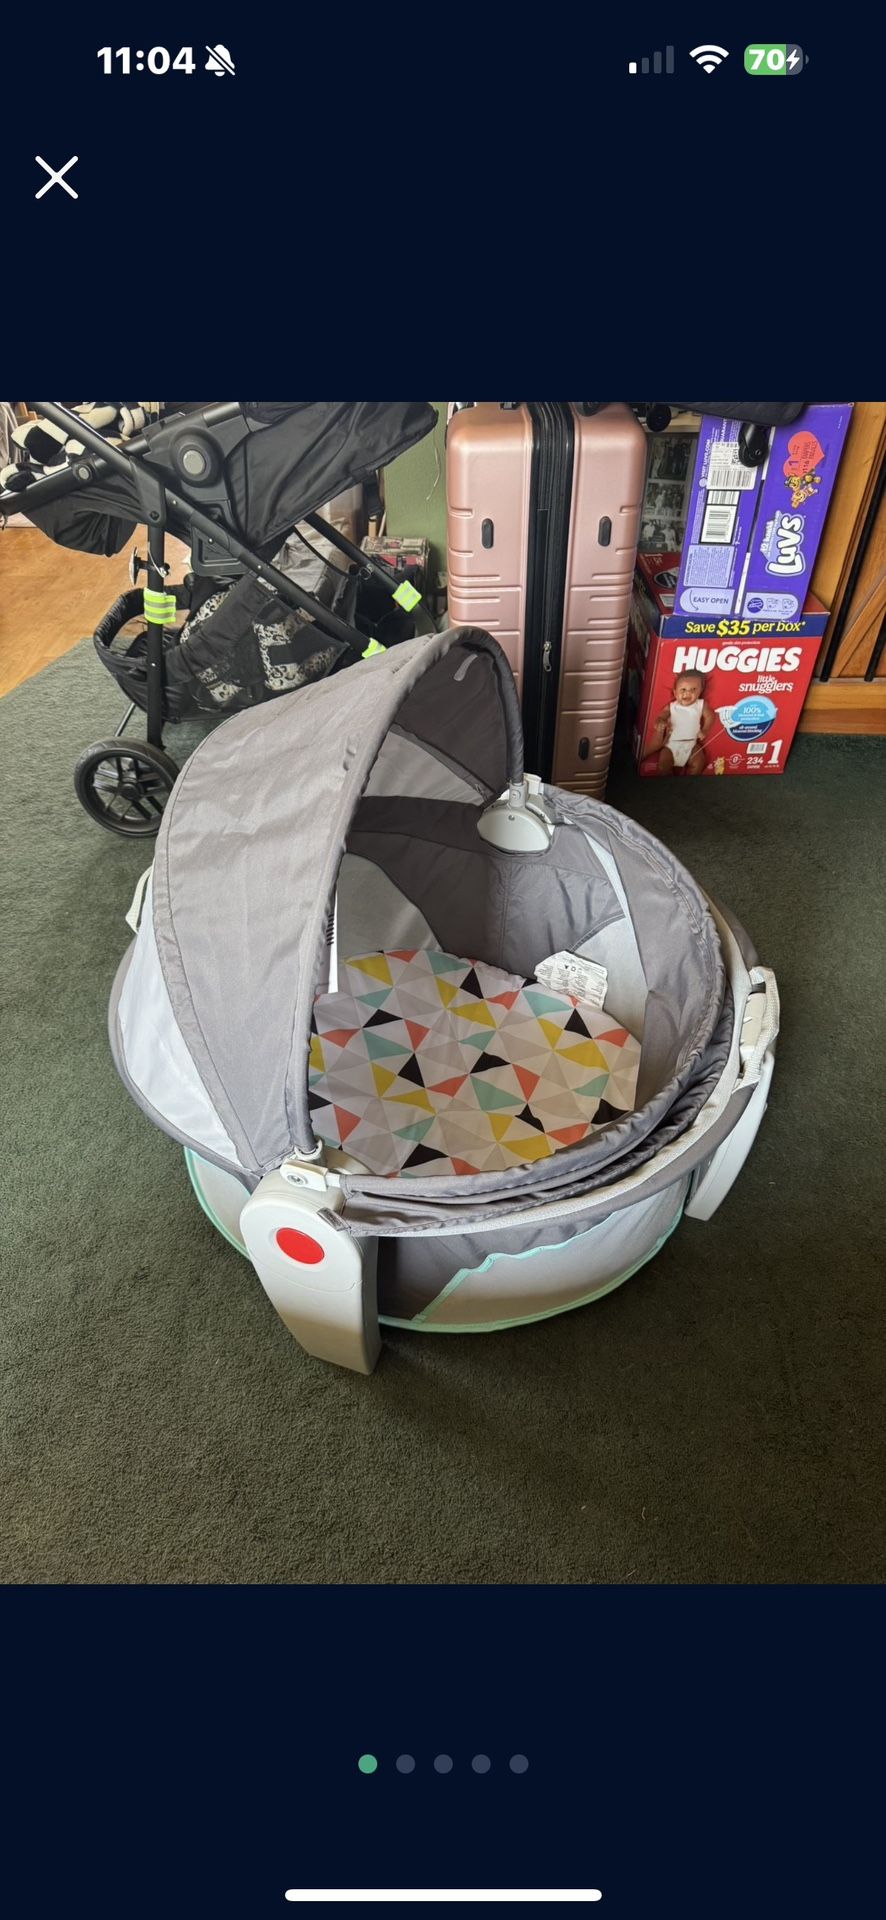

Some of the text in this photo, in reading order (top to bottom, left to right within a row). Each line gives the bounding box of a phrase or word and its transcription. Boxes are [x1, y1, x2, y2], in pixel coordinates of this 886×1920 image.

[693, 596, 729, 605] EASY OPEN
[685, 621, 716, 634] Save
[716, 618, 750, 637] $35
[752, 621, 775, 635] per
[672, 645, 803, 674] HUGGIES
[756, 674, 776, 683] little
[738, 680, 794, 694] snugglers
[767, 739, 783, 764] 1
